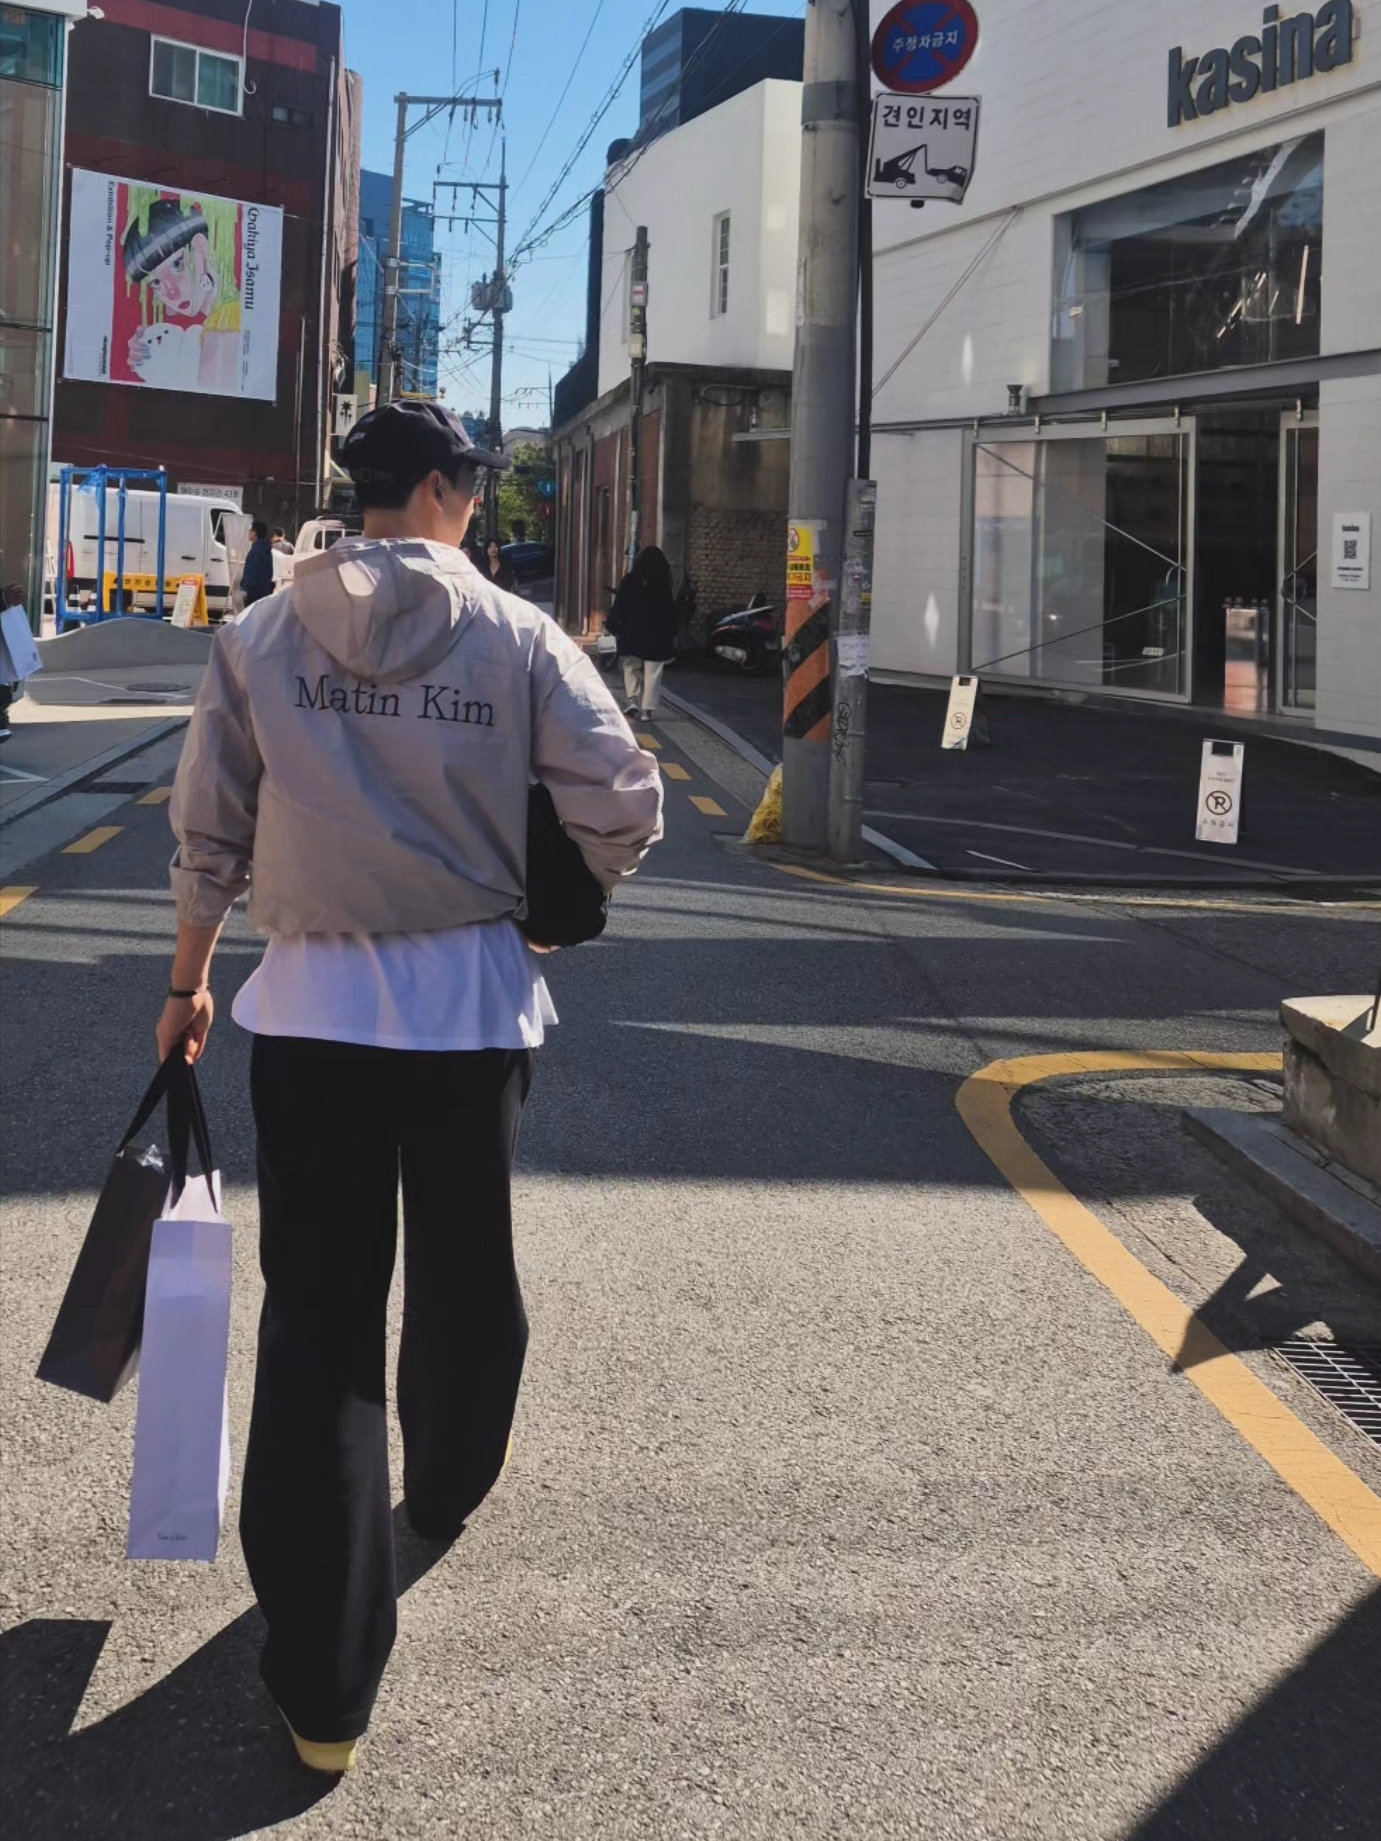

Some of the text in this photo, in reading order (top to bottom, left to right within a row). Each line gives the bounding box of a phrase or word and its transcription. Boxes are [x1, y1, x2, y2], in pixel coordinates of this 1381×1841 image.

[891, 29, 958, 53] 주정차금지
[1167, 0, 1353, 128] kasina
[882, 104, 971, 131] 견인지역
[106, 181, 115, 225] Exhibition
[104, 233, 113, 266] Pop-up
[294, 675, 495, 727] Matin Kim
